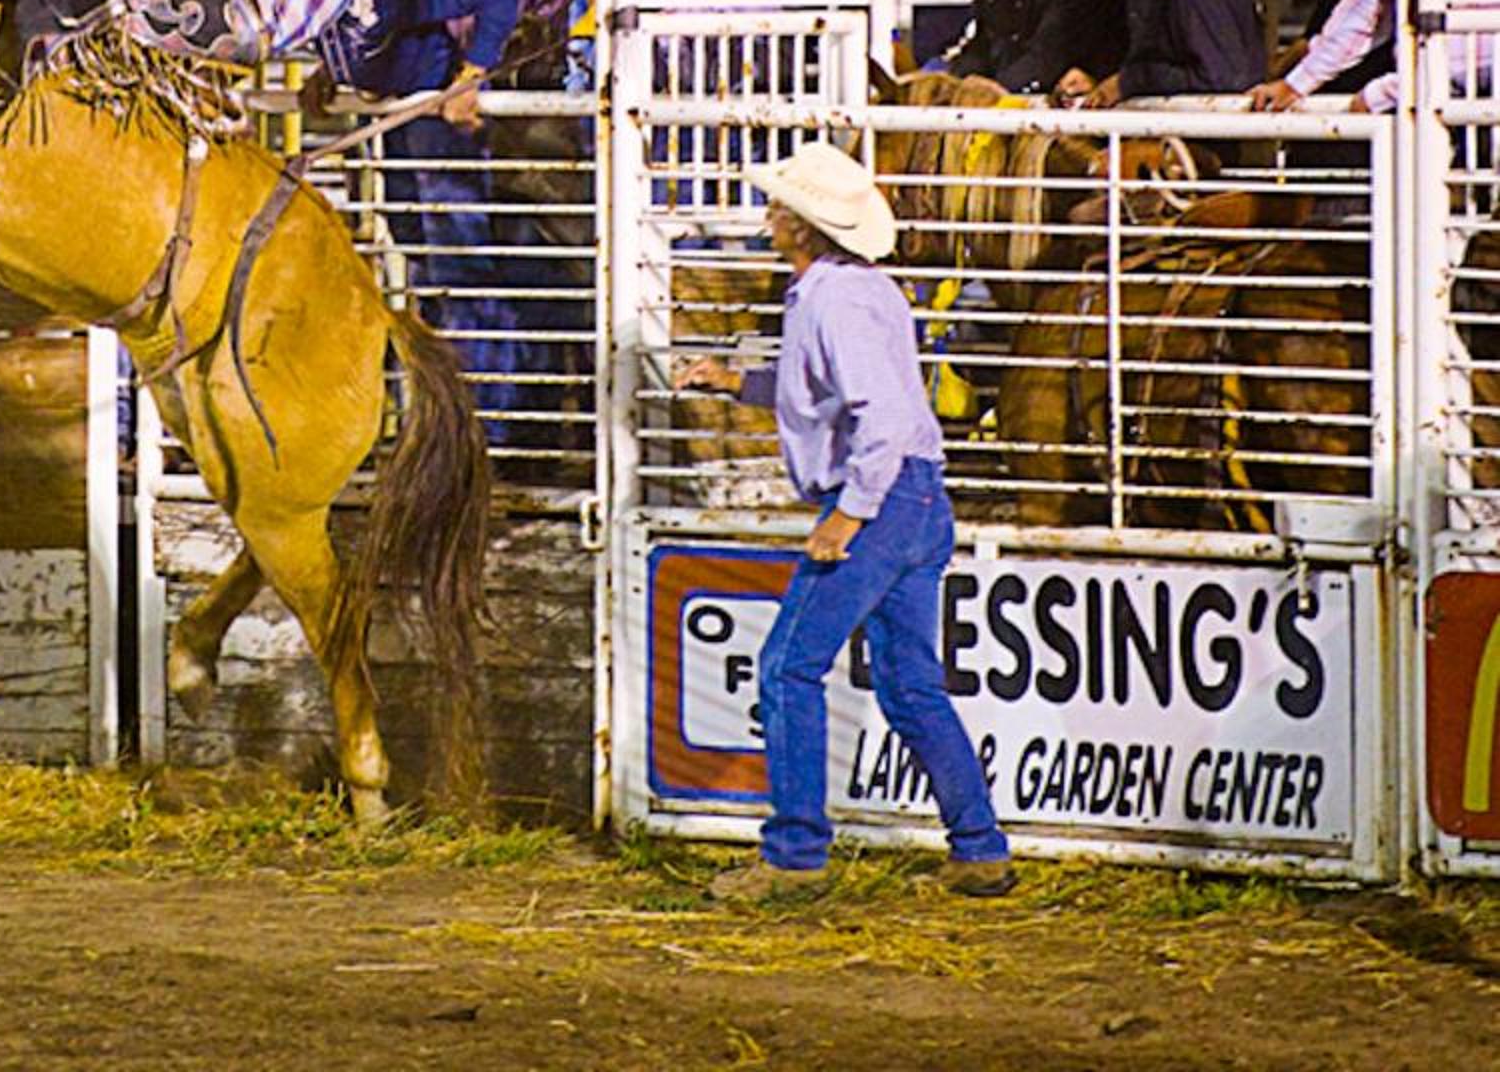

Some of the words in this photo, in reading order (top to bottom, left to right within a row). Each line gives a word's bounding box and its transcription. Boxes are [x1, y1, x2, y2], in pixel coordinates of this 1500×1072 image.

[849, 573, 1326, 719] ESSING'S
[848, 728, 938, 802] LAW
[1014, 736, 1173, 817] GARDEN
[1183, 747, 1324, 829] CENTER
